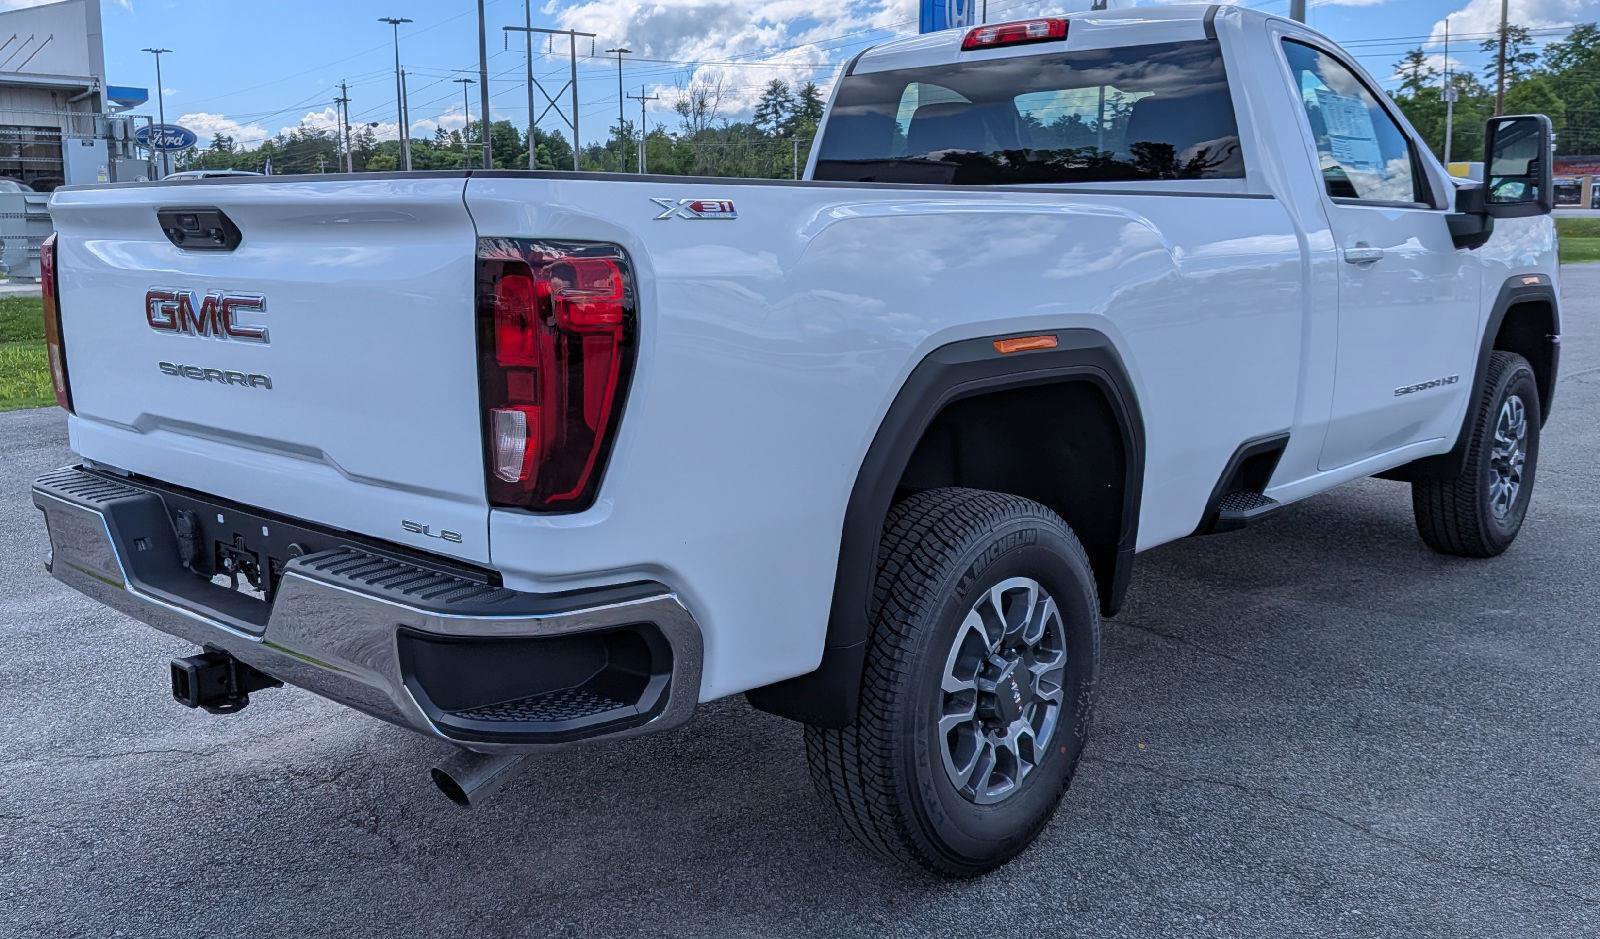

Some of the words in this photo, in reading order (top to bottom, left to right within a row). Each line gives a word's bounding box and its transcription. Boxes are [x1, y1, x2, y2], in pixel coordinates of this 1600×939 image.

[649, 197, 738, 220] X31
[145, 286, 271, 345] GMC
[158, 361, 273, 390] SIERRA
[1394, 378, 1441, 397] SIERRA
[1441, 374, 1459, 386] HD
[401, 519, 463, 544] SLE
[973, 528, 1038, 577] MICHELIN
